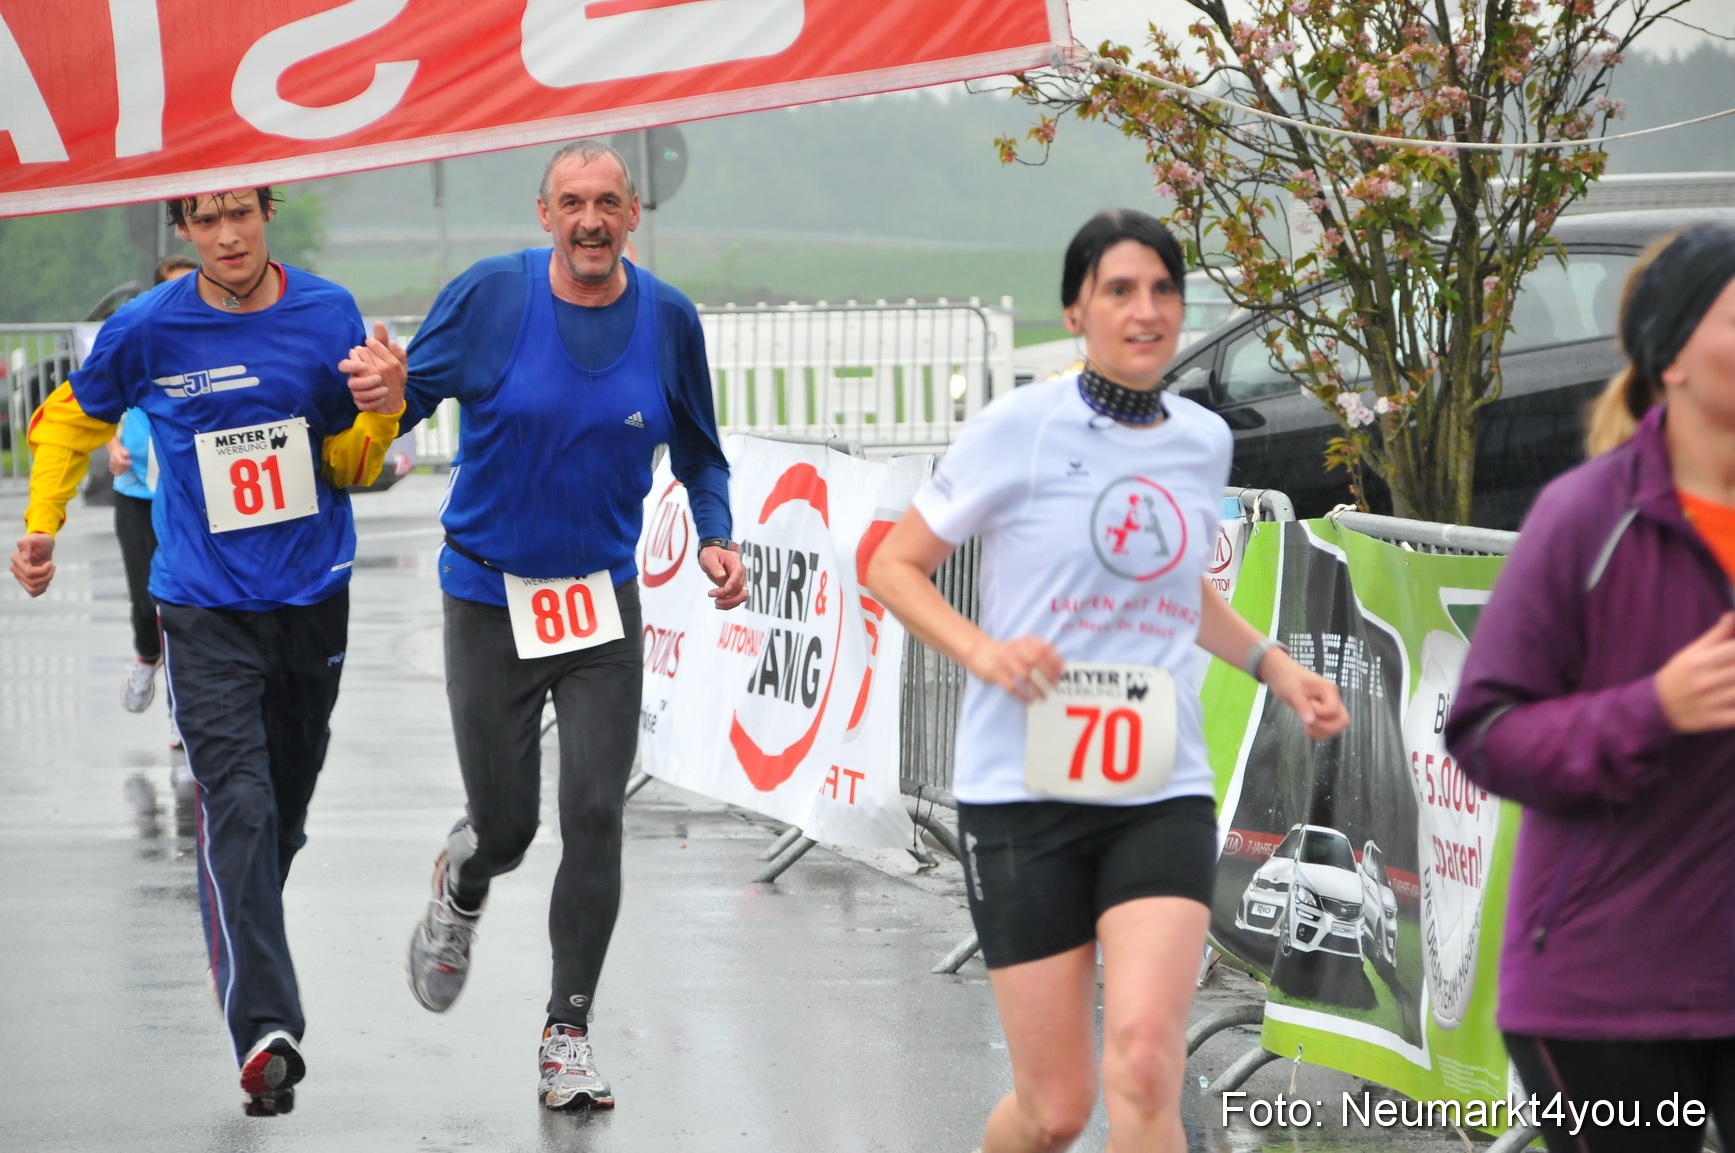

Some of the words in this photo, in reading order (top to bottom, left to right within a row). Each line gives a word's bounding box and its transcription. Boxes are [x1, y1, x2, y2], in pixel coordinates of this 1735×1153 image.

[215, 430, 265, 448] MEYER
[215, 440, 268, 456] WERBUNG
[229, 455, 286, 516] 81
[531, 583, 599, 645] 80
[815, 570, 828, 617] &
[1433, 692, 1450, 735] Bi
[1065, 704, 1142, 784] 70
